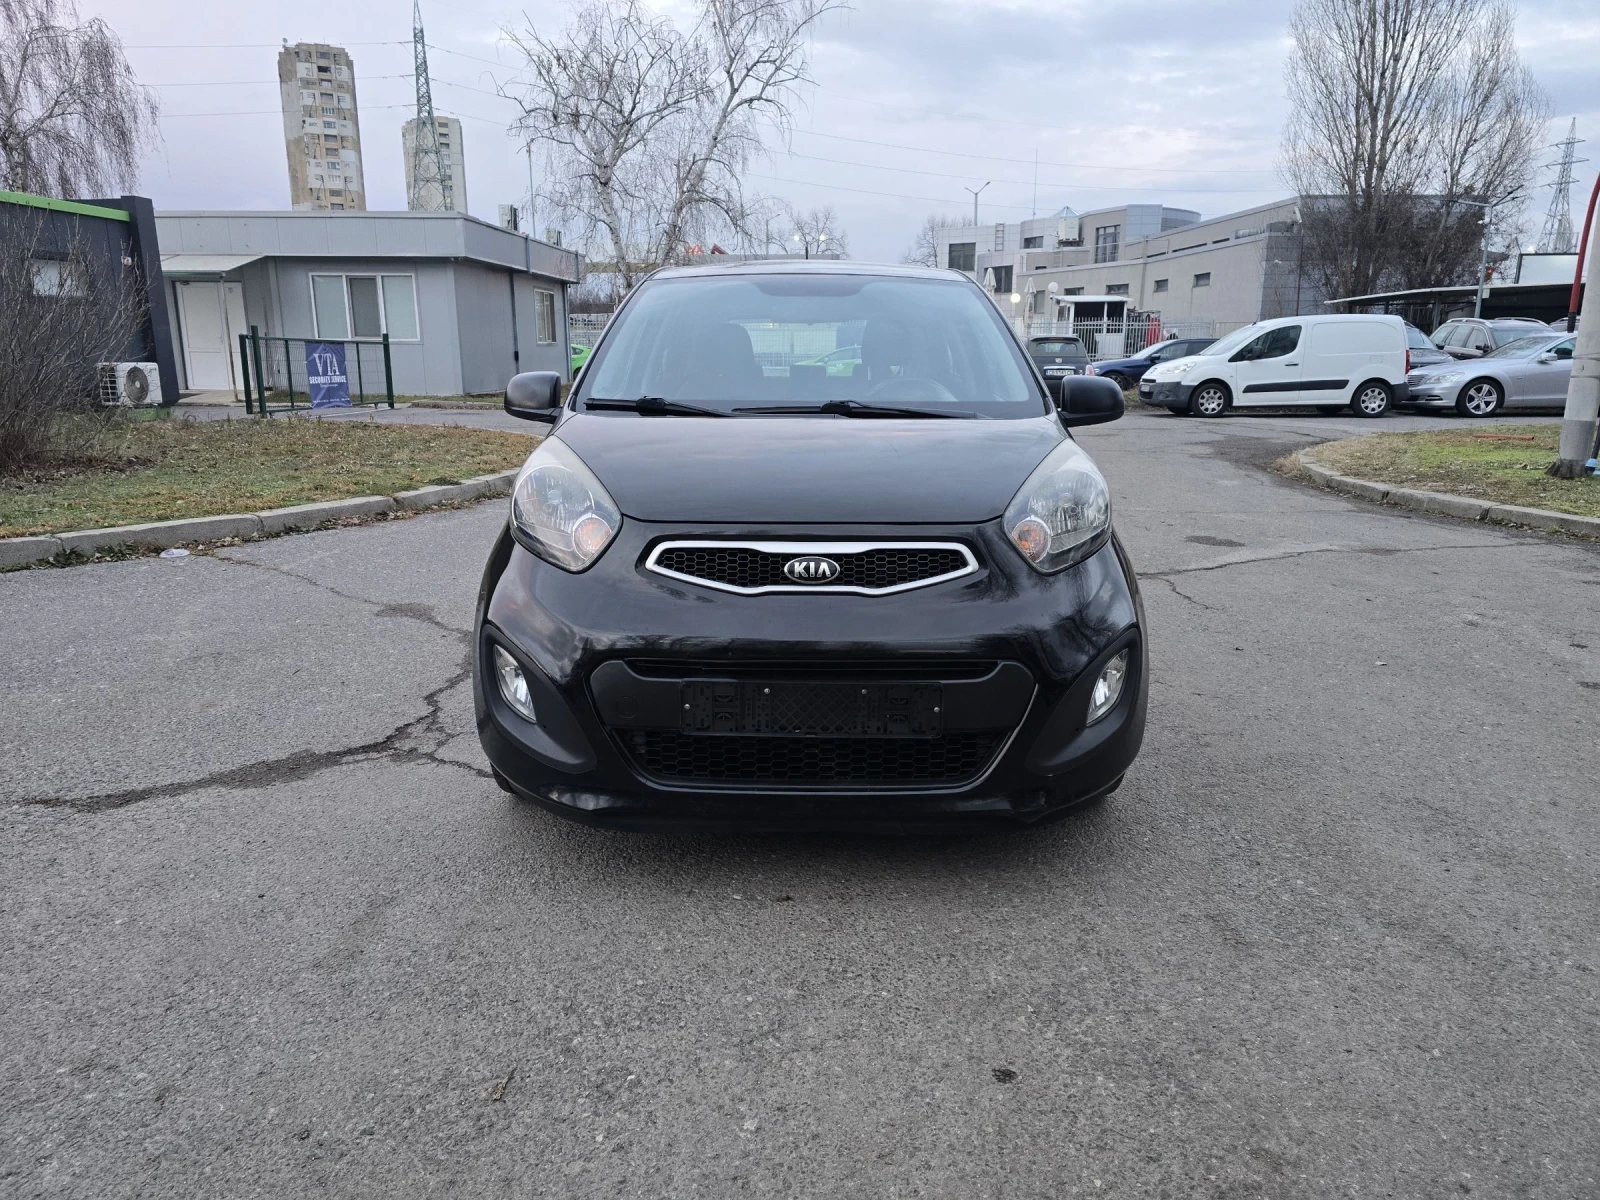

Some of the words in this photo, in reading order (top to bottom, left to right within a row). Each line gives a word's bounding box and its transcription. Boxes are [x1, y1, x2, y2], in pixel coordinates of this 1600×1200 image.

[313, 353, 340, 375] VTA
[309, 376, 330, 384] SECURITY
[331, 375, 347, 383] SERVICE
[793, 561, 832, 578] KIA
